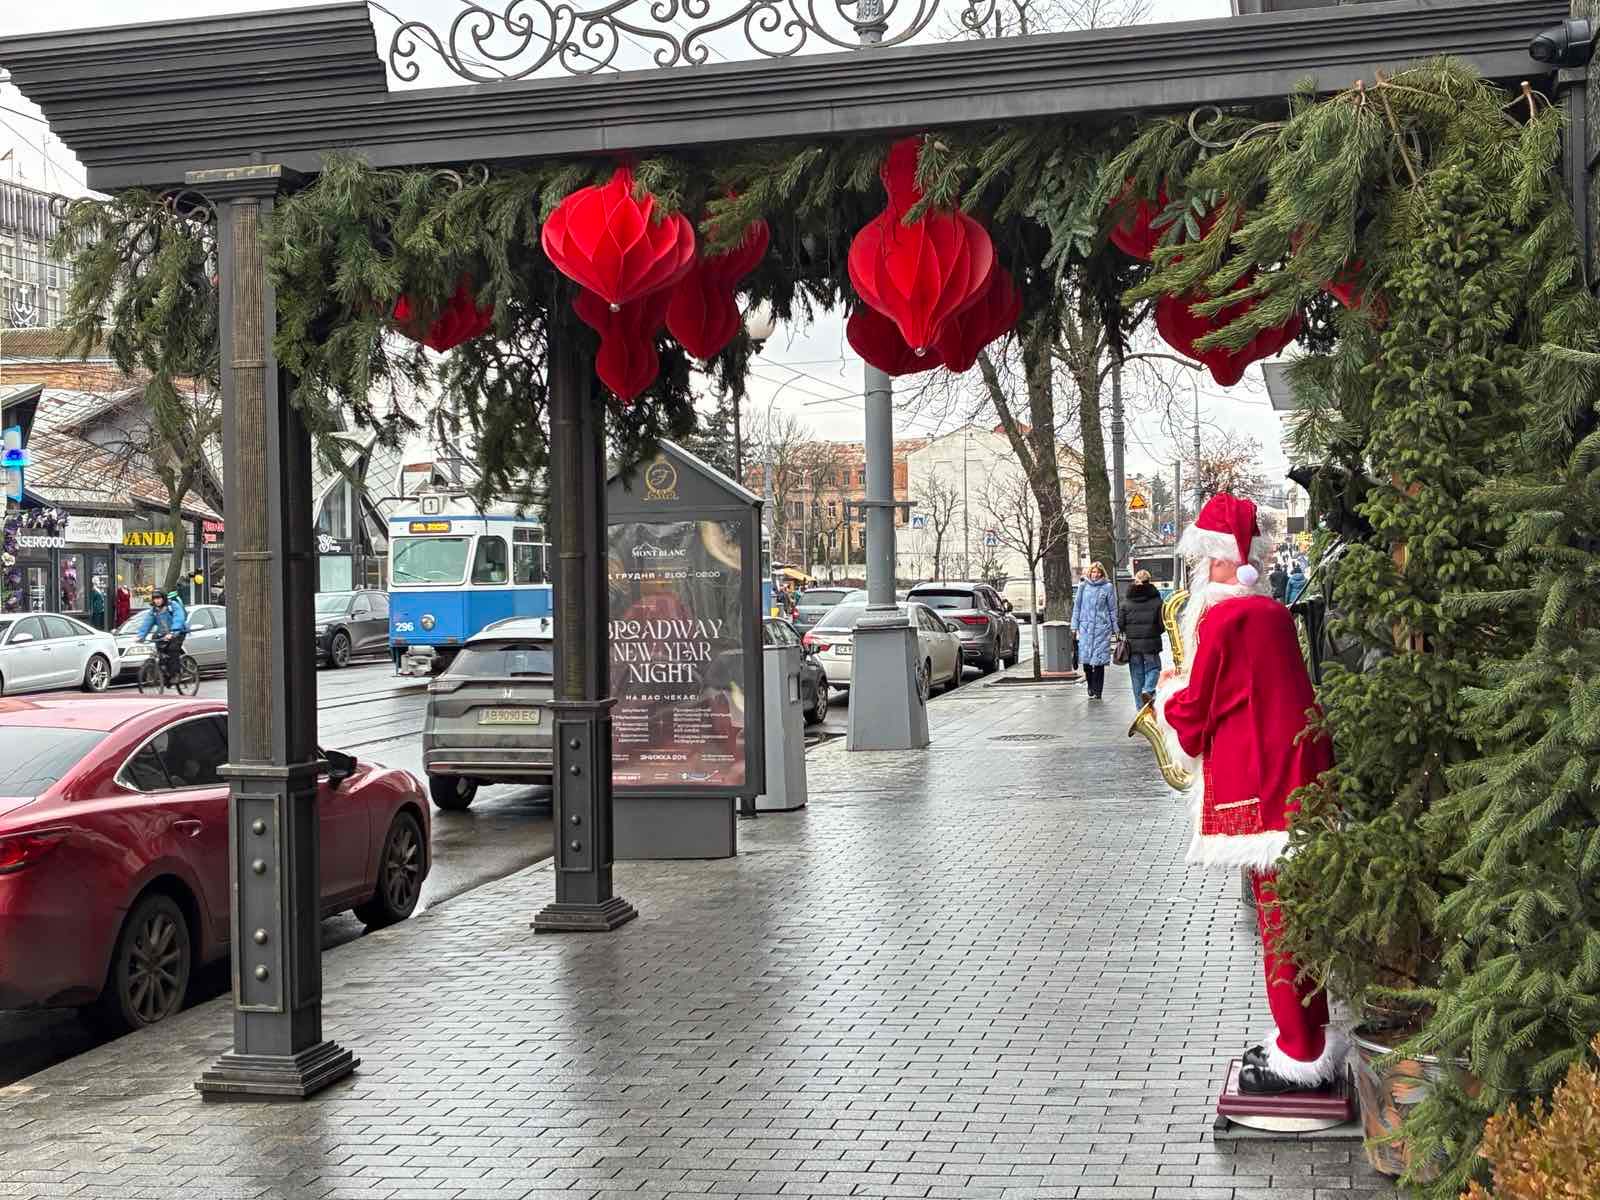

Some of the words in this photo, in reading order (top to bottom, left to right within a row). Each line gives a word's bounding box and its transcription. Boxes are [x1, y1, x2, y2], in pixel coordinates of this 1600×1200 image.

[123, 531, 174, 546] VANDA
[396, 622, 414, 632] 296
[614, 642, 657, 662] NEW
[664, 641, 712, 661] YEAR
[628, 663, 698, 683] NIGHT
